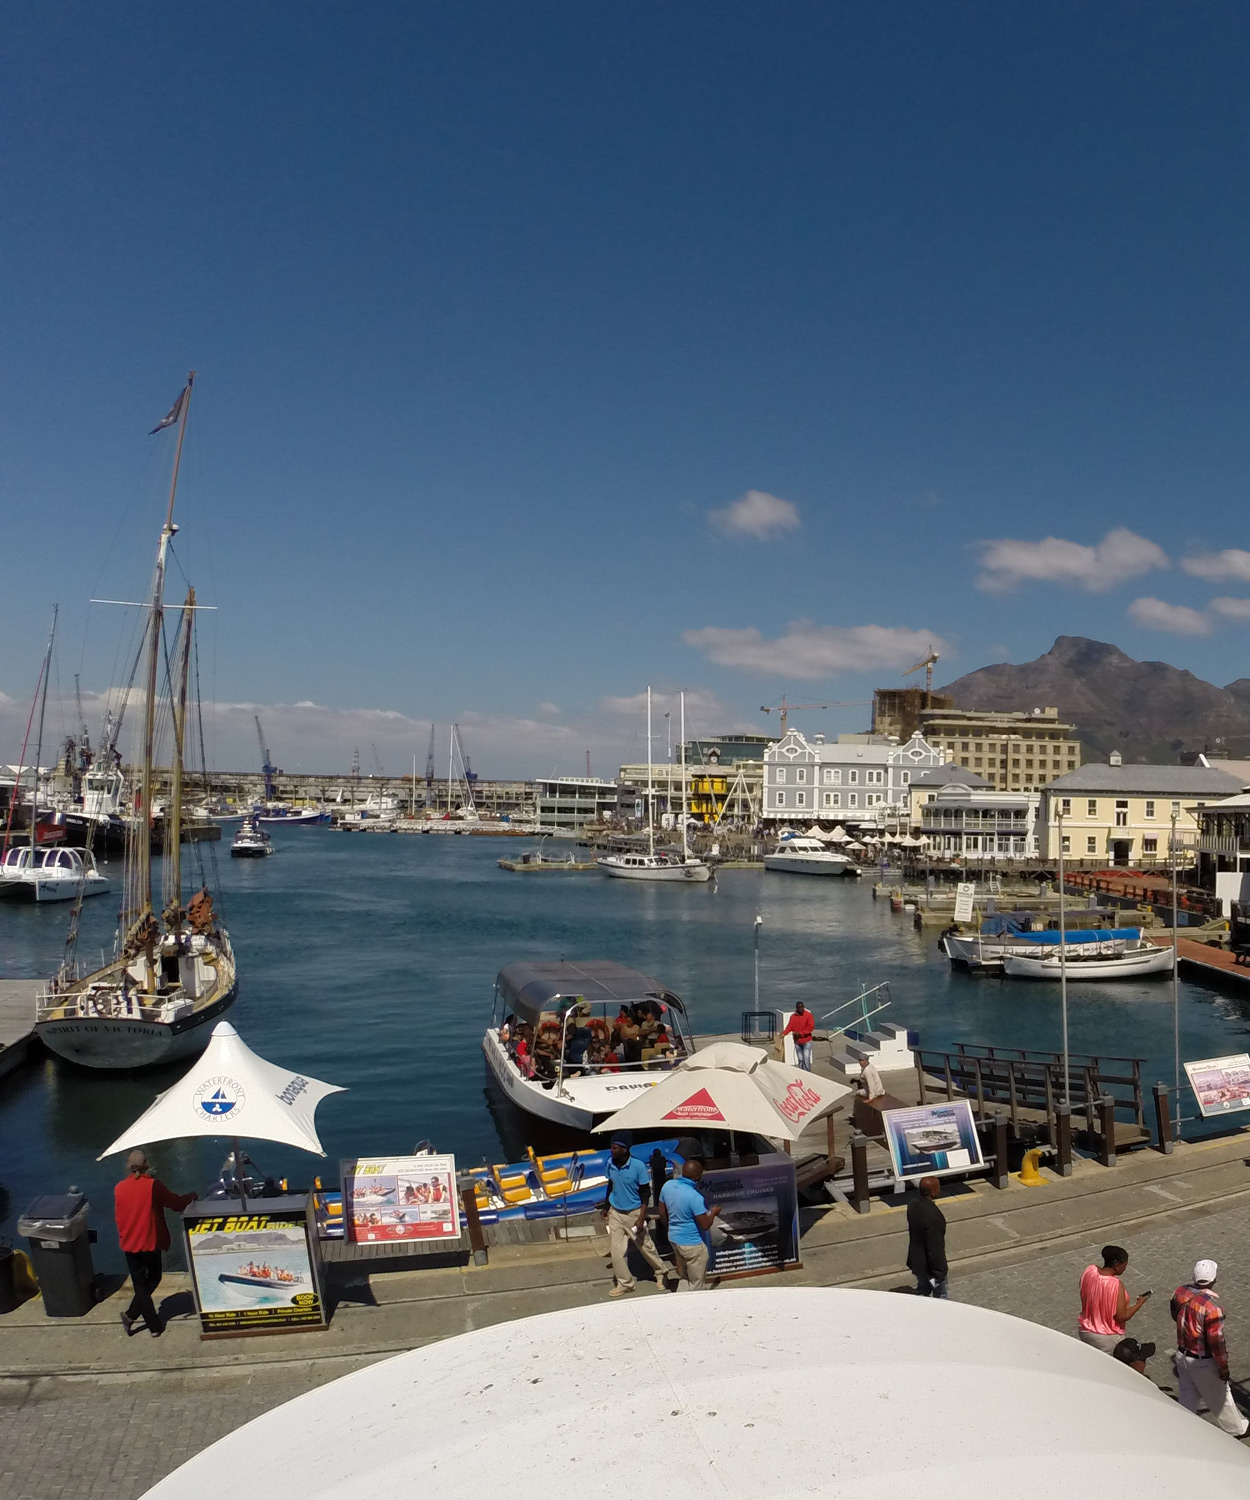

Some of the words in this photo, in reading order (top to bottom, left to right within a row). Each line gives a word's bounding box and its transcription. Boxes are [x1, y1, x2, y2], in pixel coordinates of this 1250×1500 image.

[85, 1024, 98, 1032] OF
[103, 1025, 162, 1036] VICTORIA
[195, 1076, 245, 1097] WATERFRONT
[195, 1106, 241, 1122] CHARTERS
[188, 1217, 223, 1236] JET
[223, 1215, 271, 1234] BOAT
